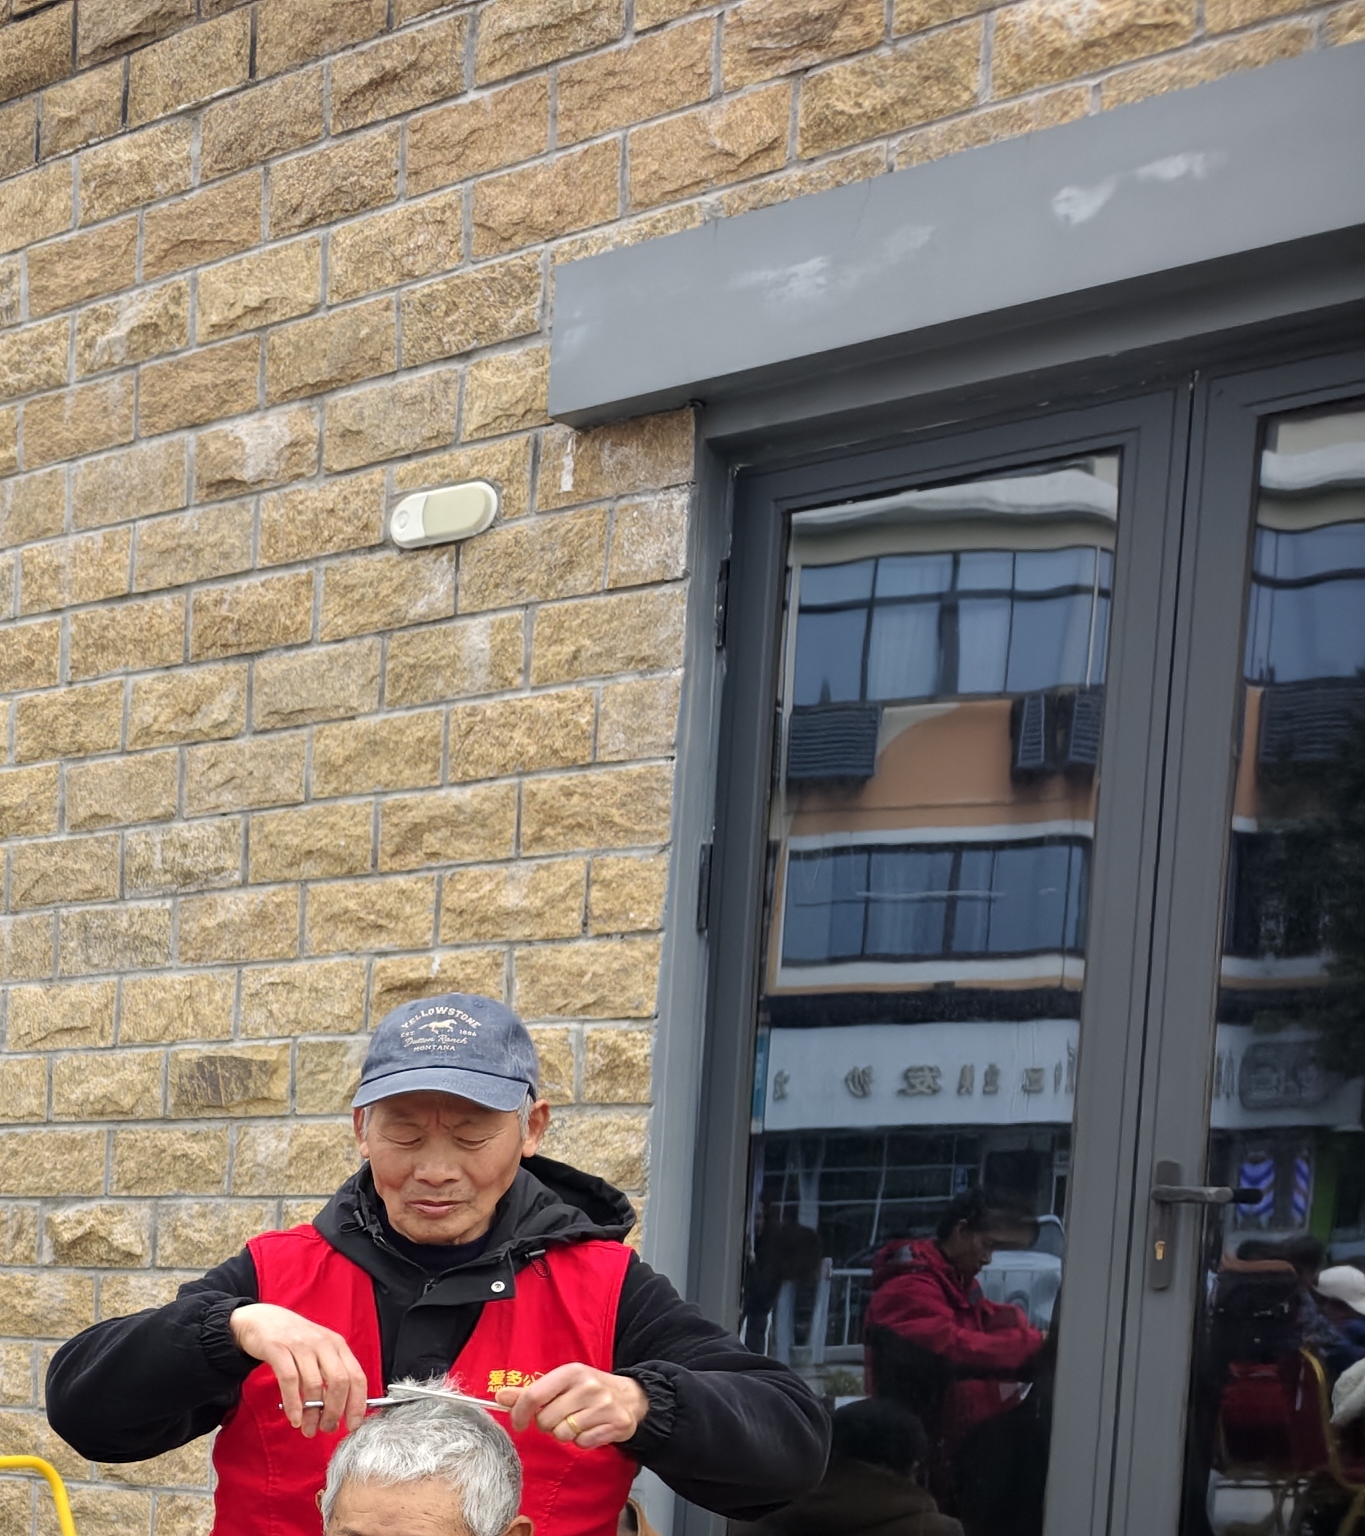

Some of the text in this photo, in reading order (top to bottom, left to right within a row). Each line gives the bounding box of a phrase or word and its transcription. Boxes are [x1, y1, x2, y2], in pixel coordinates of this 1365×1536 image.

[400, 1006, 482, 1029] YELLOWSTONE
[437, 1033, 468, 1045] Ranch
[413, 1044, 456, 1052] MONTANA
